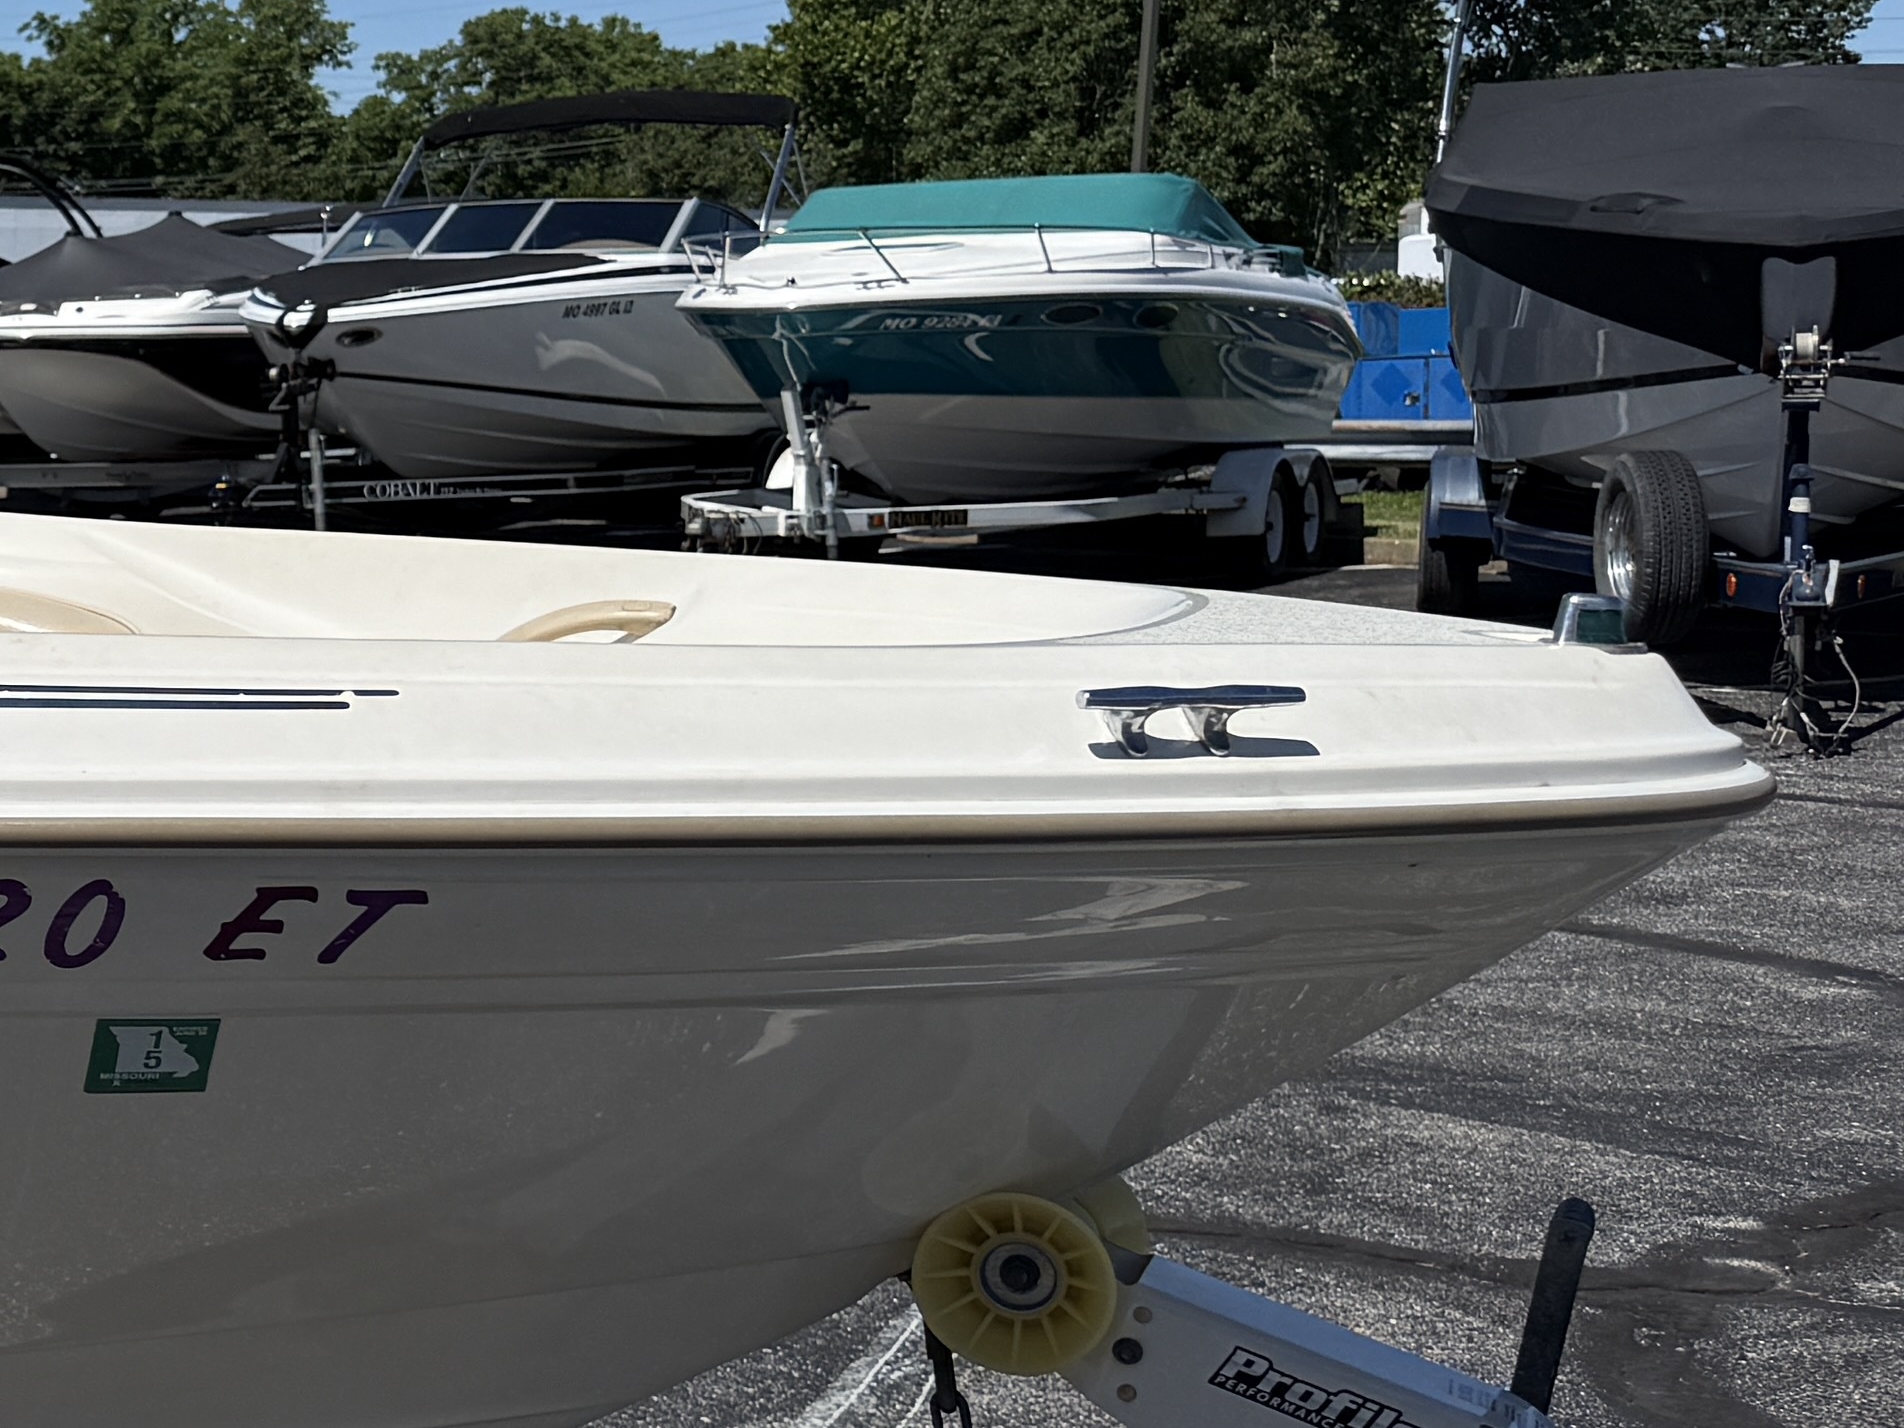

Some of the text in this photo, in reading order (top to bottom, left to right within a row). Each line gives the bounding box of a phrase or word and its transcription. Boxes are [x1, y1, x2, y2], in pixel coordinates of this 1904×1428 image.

[879, 317, 917, 330] MO
[363, 479, 439, 500] COBALT
[202, 885, 429, 964] ET
[99, 1072, 160, 1080] MISSOURI
